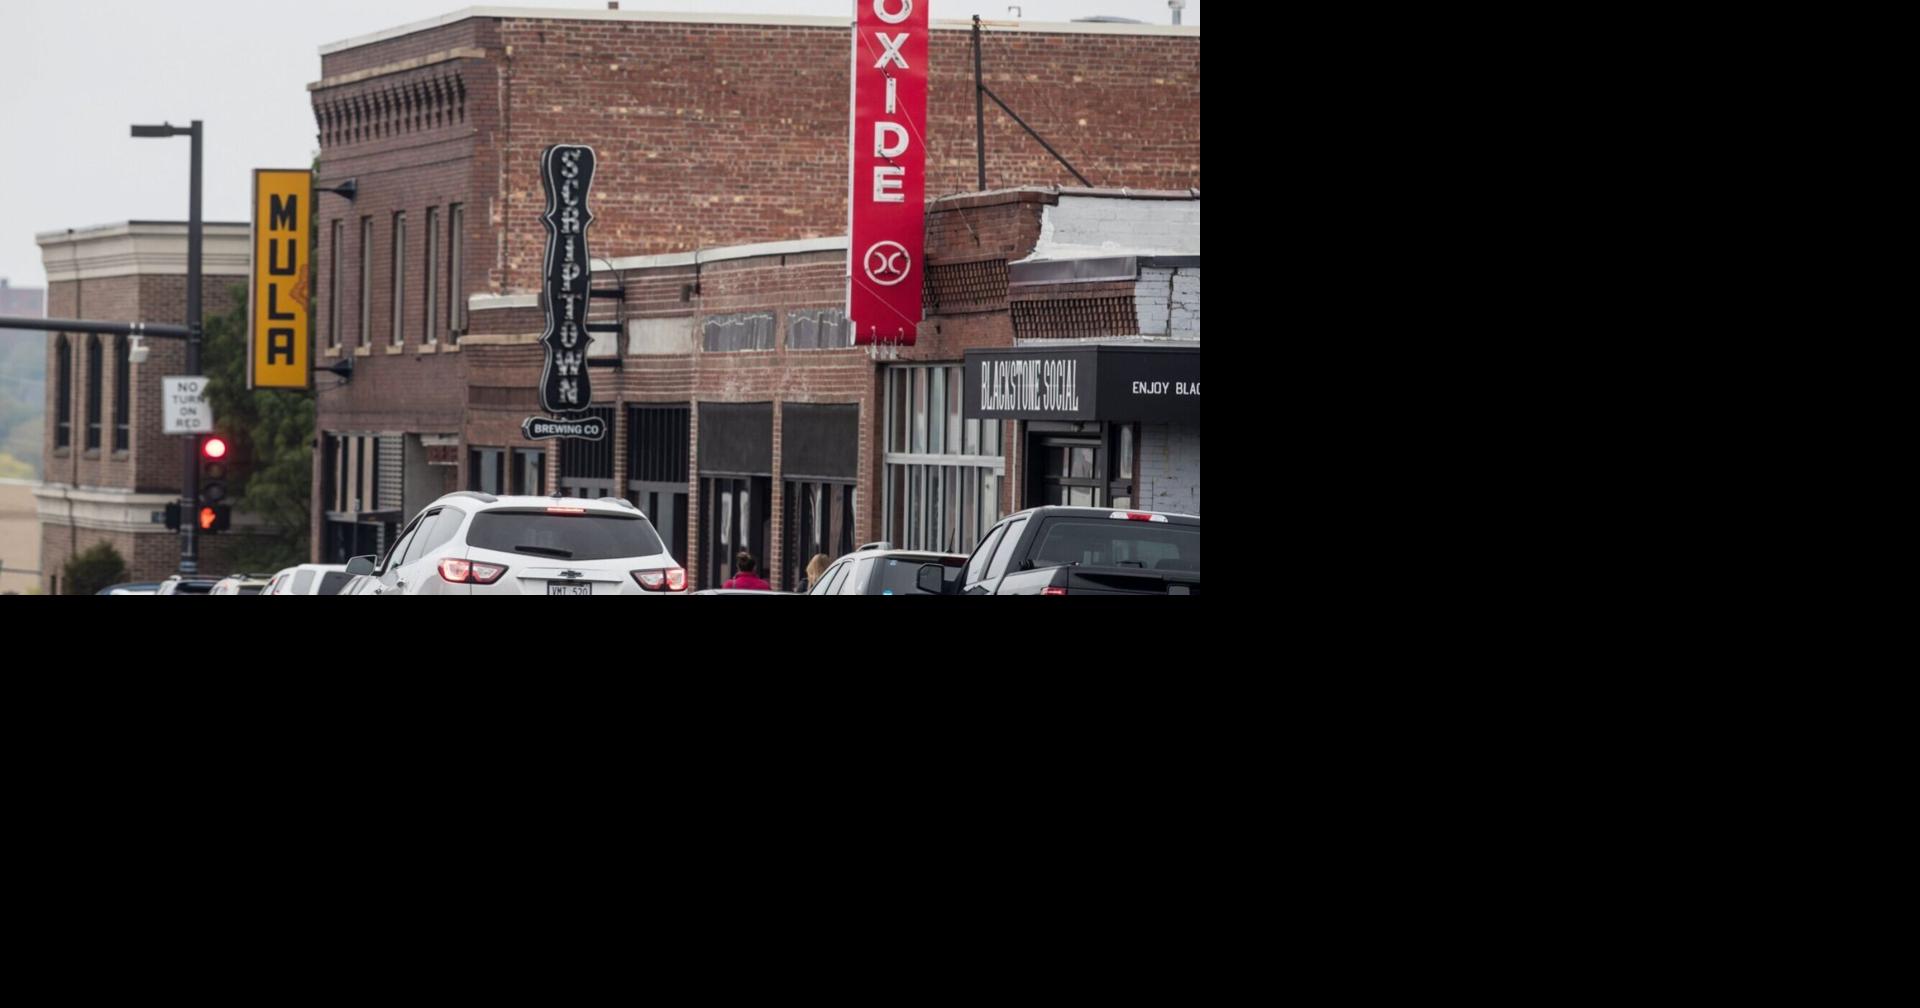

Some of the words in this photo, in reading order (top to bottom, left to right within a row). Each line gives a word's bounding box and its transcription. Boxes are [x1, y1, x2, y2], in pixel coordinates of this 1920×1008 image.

[873, 0, 913, 202] OXIDE
[267, 194, 297, 365] MULA
[556, 150, 582, 404] SCRIPTOWN
[177, 382, 198, 392] NO
[981, 360, 1041, 411] BLACKSTONE
[1043, 360, 1079, 411] SOCIAL
[1132, 381, 1169, 394] ENJOY
[173, 395, 205, 404] TURN
[179, 407, 198, 416] ON
[175, 418, 202, 428] RED
[534, 424, 582, 434] BREWING
[583, 425, 599, 434] CO
